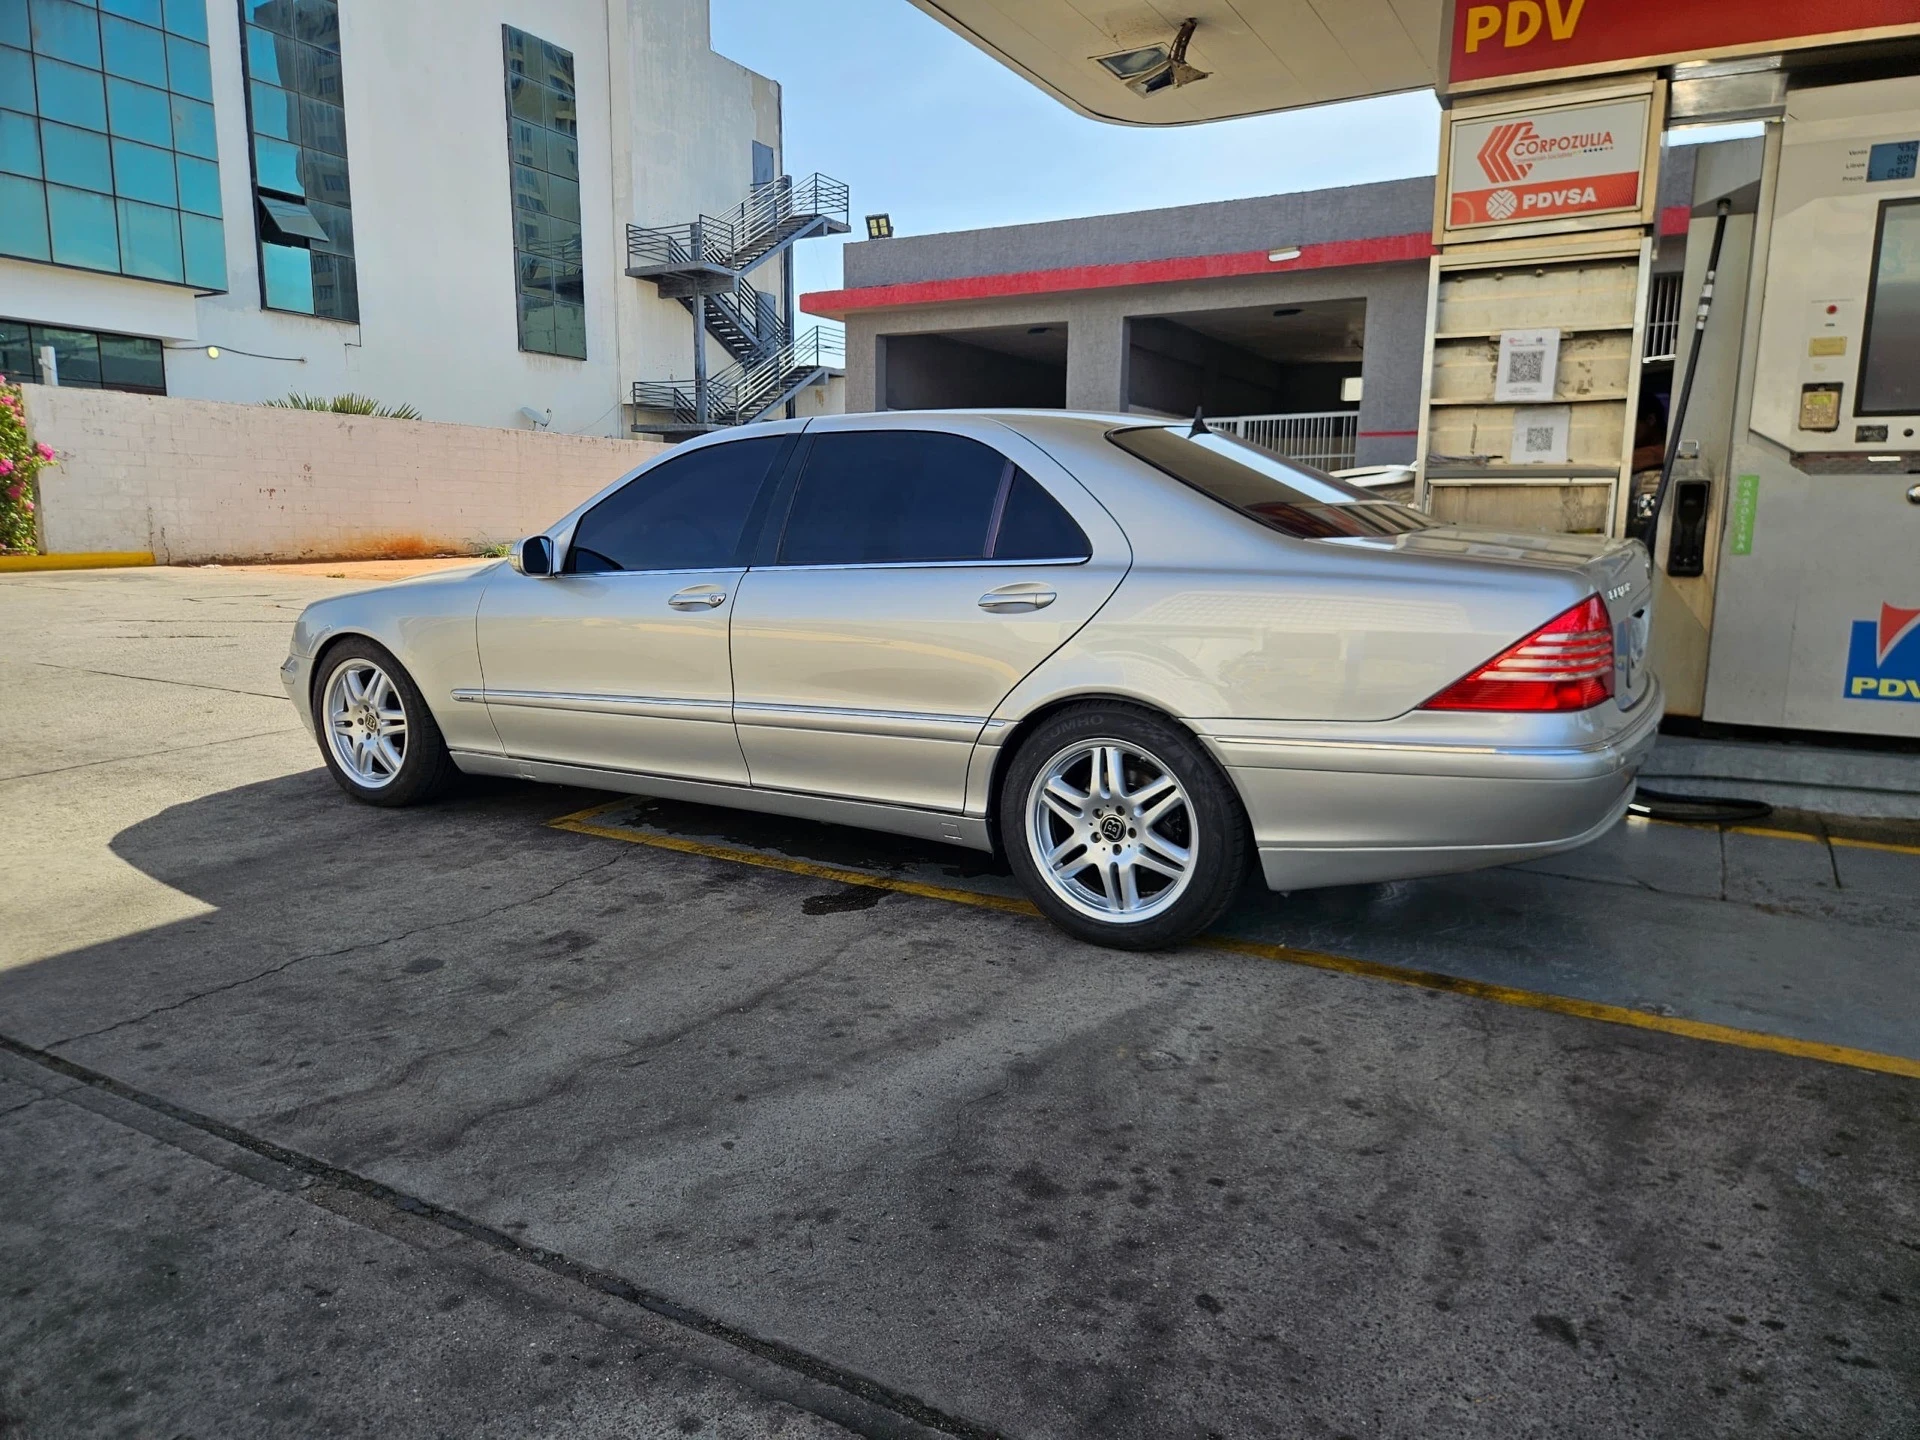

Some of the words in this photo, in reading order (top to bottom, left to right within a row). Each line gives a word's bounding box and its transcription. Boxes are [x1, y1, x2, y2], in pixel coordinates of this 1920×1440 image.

[1465, 0, 1585, 53] PDV
[1513, 131, 1613, 156] CORPOZULIA
[1522, 187, 1597, 210] PDVSA
[1040, 714, 1104, 741] UMHO
